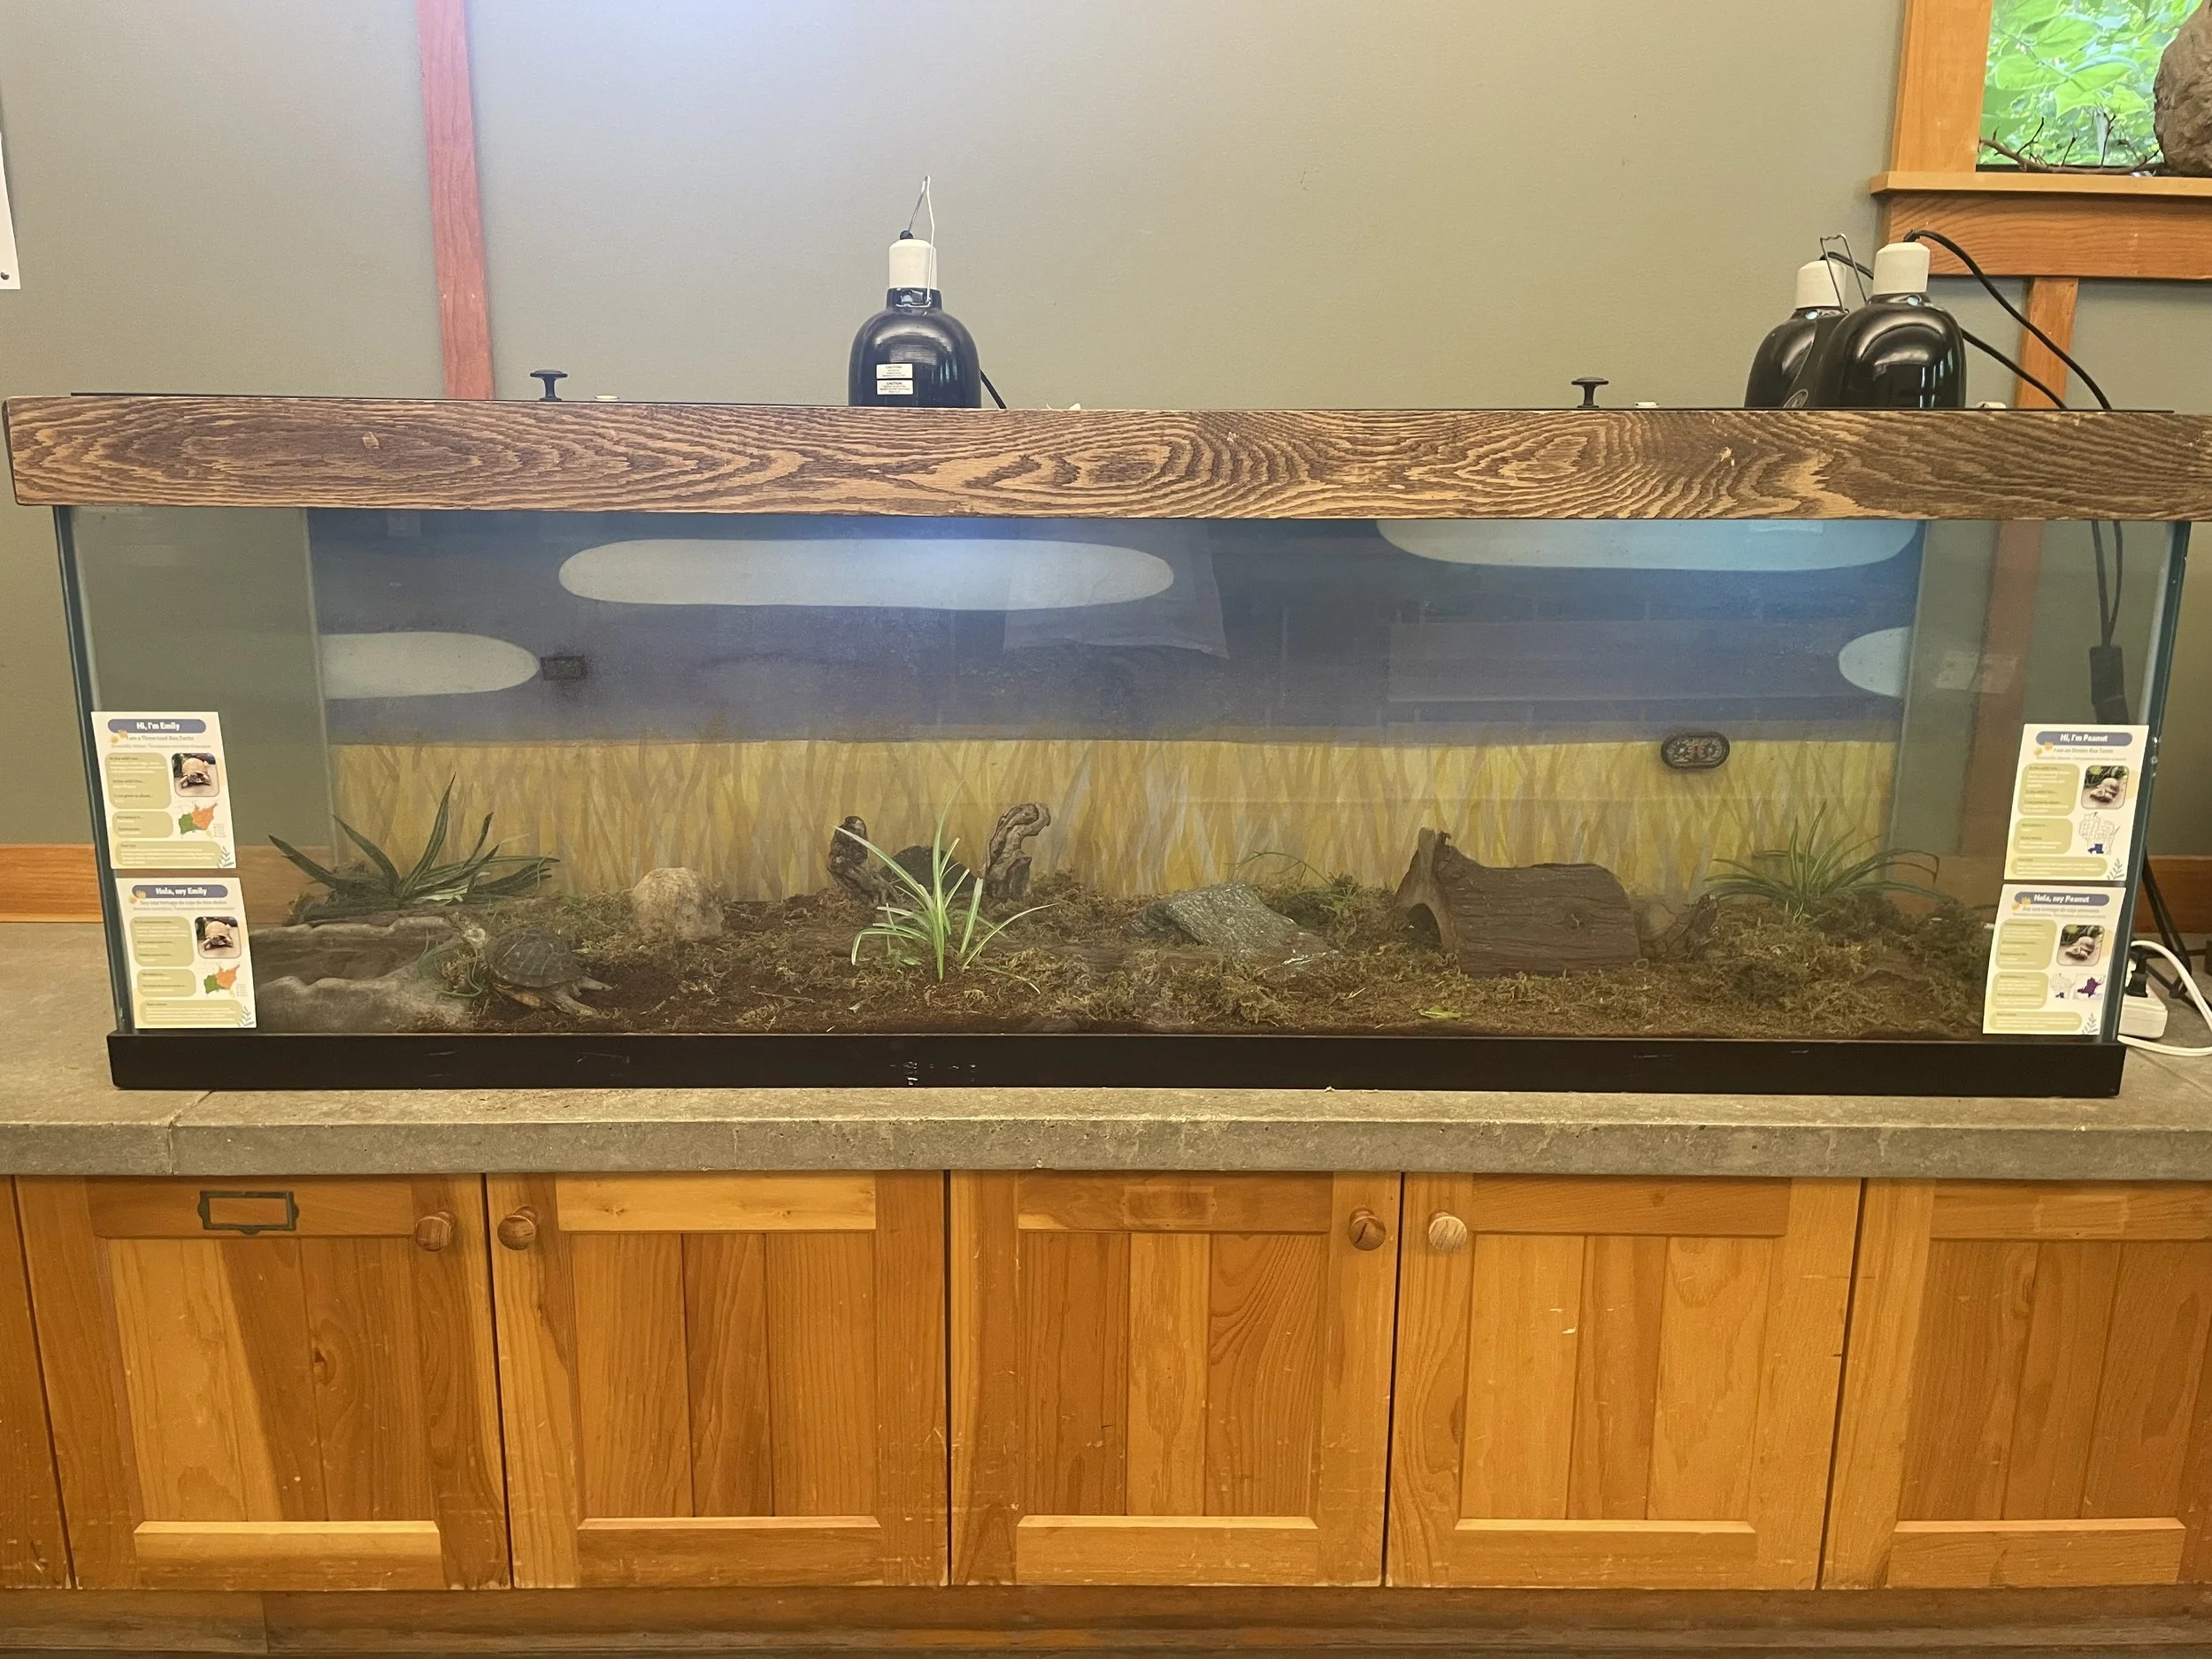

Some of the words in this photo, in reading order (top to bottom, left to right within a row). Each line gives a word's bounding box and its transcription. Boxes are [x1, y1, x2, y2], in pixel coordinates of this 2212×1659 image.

[136, 721, 148, 731] Hi,
[148, 721, 159, 730] I'm
[159, 721, 180, 732] Emily
[2060, 733, 2070, 742] Hi,
[2071, 733, 2083, 742] I'm
[2083, 733, 2108, 742] Peanut
[155, 887, 174, 895] Hola,
[187, 887, 207, 896] Emily
[2033, 894, 2051, 902] Hola,
[2053, 895, 2064, 904] soy
